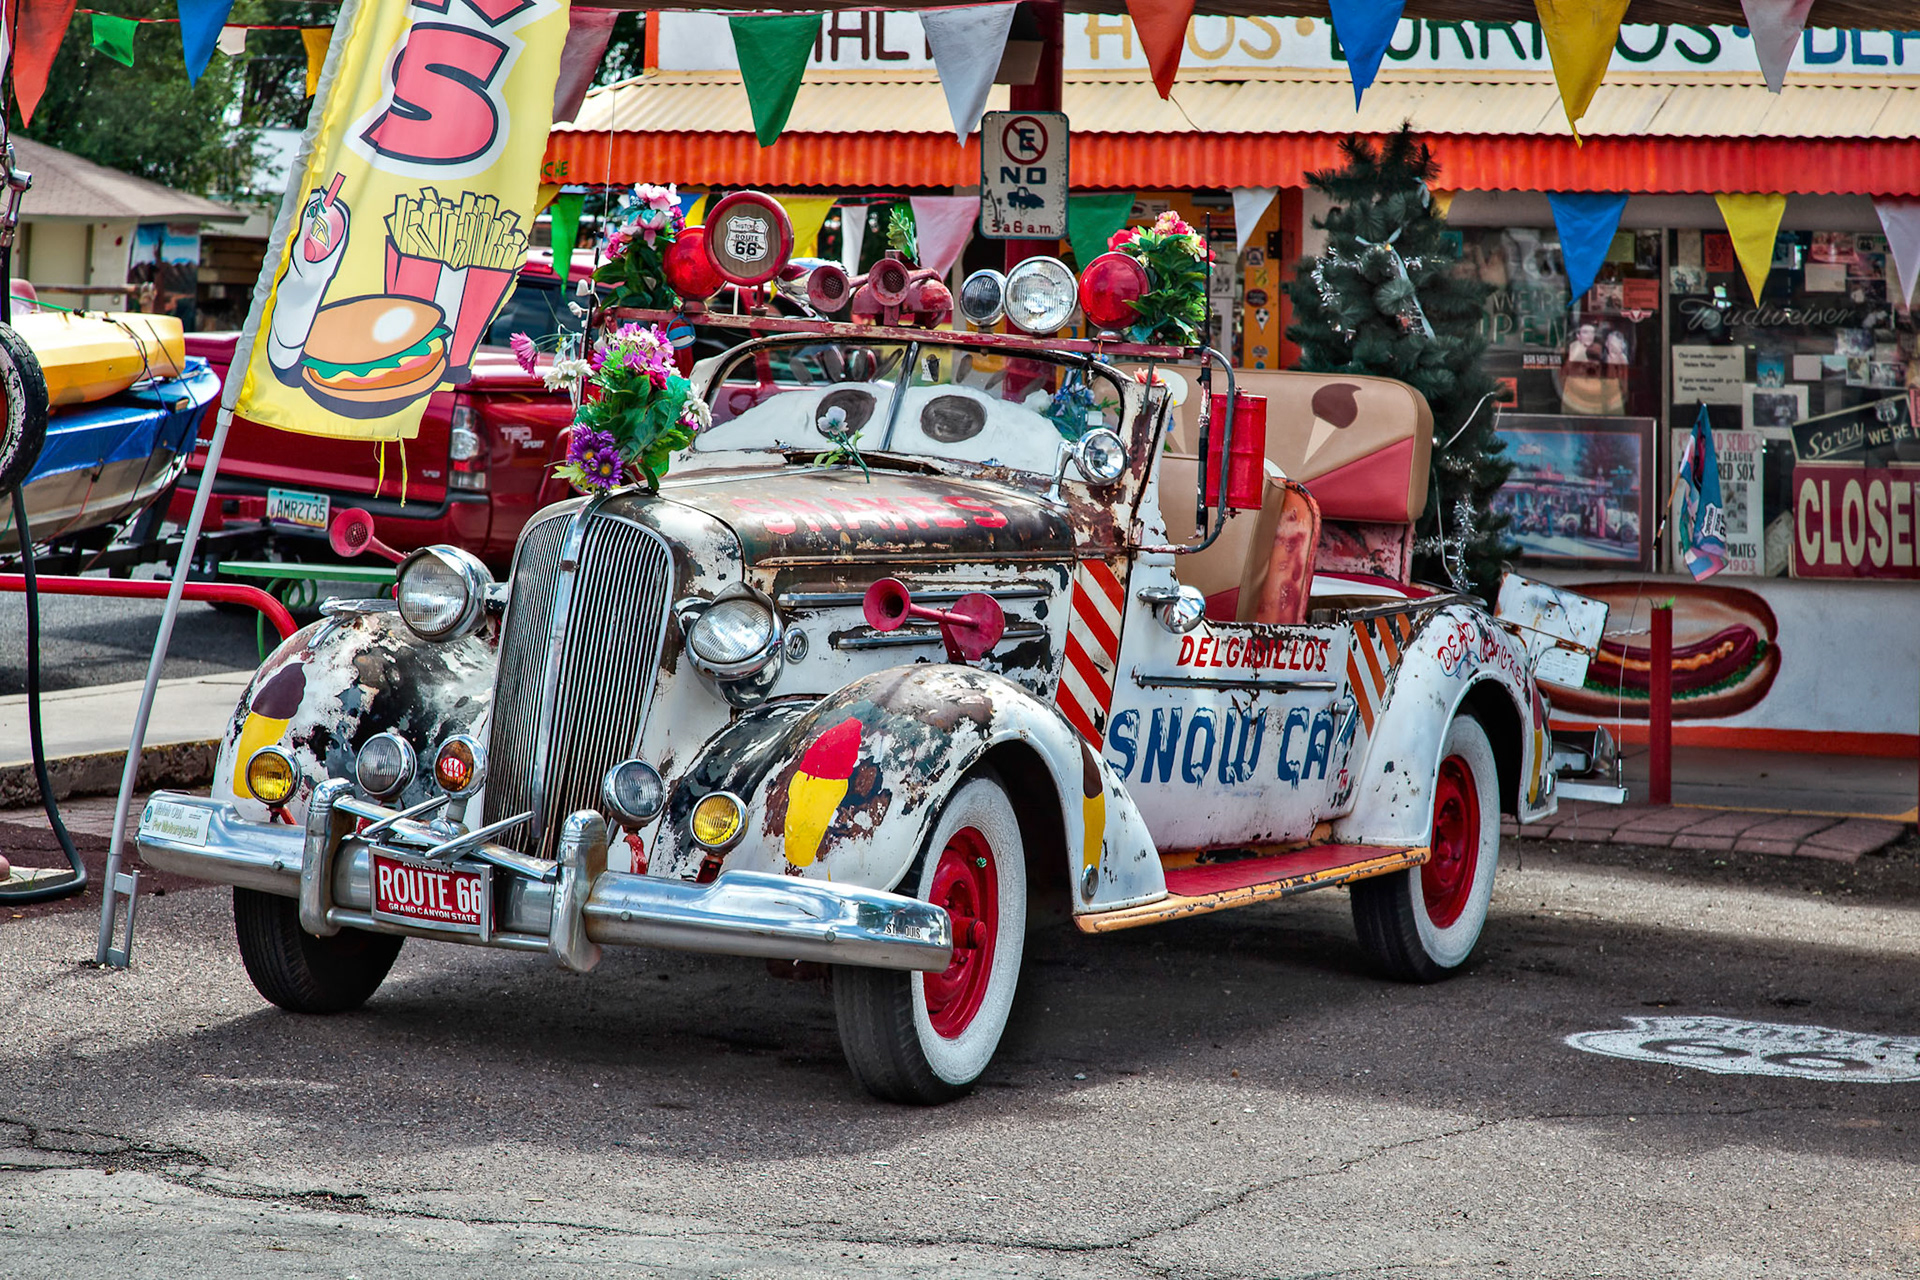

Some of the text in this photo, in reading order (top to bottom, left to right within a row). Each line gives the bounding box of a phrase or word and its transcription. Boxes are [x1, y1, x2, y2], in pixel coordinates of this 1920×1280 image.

[360, 0, 536, 166] S
[1000, 166, 1047, 185] NO
[735, 234, 759, 242] ROUTE
[1027, 223, 1055, 234] a.m.
[735, 241, 757, 256] 66
[1678, 298, 1853, 330] Budweiser
[1480, 313, 1568, 348] PEN
[500, 426, 532, 444] TRD
[1726, 432, 1757, 452] SERIES
[1805, 422, 1910, 459] Sorry WE'RE
[1724, 451, 1754, 462] LEAGUE
[1737, 463, 1755, 481] SOX
[276, 499, 326, 522] AMR2735
[730, 495, 1009, 535] SHAKES
[1798, 477, 1920, 568] CLOSE
[1728, 559, 1756, 572] 1903
[1176, 635, 1331, 672] DELGADILLO'S
[1437, 622, 1476, 671] DEAD
[1106, 706, 1269, 789] SNOW
[378, 865, 480, 915] ROUTE 66
[388, 902, 477, 923] GRAND CANYON STATE
